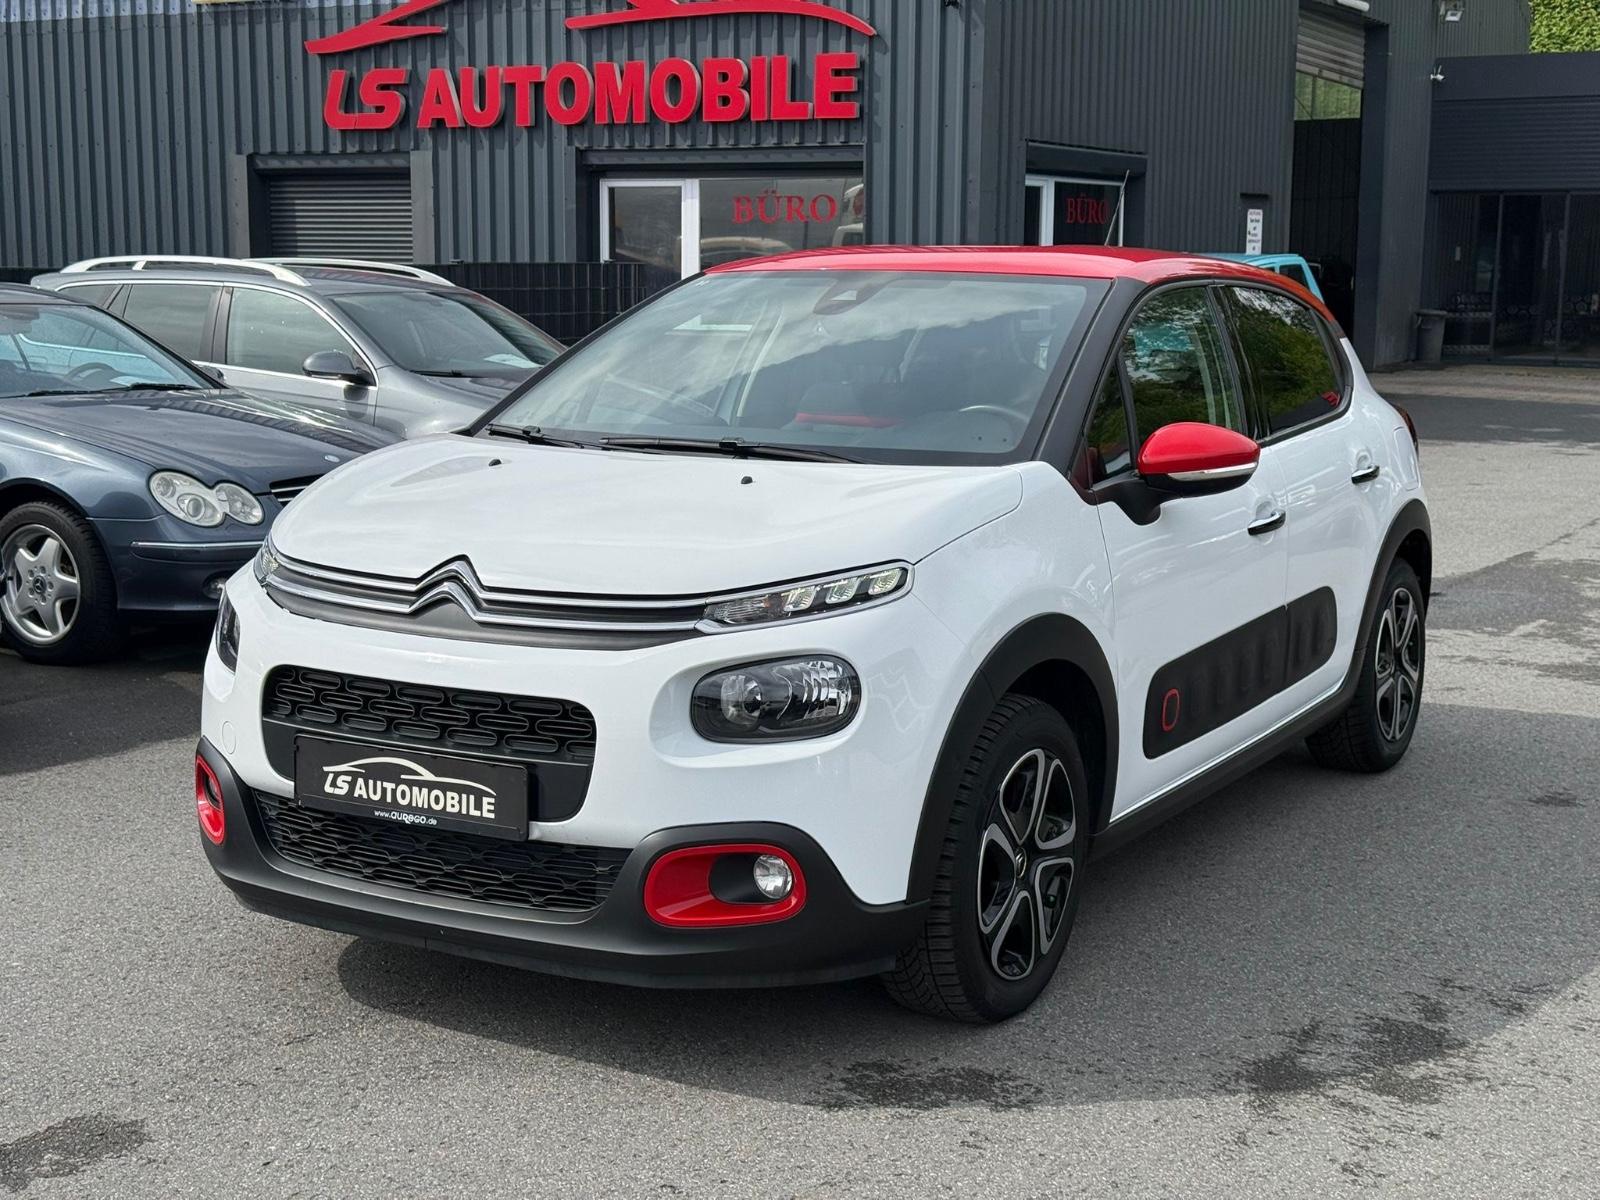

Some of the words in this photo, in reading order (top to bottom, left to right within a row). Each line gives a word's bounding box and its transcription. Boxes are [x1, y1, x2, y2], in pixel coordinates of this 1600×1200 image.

[323, 68, 409, 130] LS
[417, 52, 861, 129] AUTOMOBILE
[732, 188, 838, 224] BÜRO
[1066, 193, 1111, 225] BÜRO
[323, 773, 352, 796] LS
[353, 777, 496, 819] AUTOMOBILE
